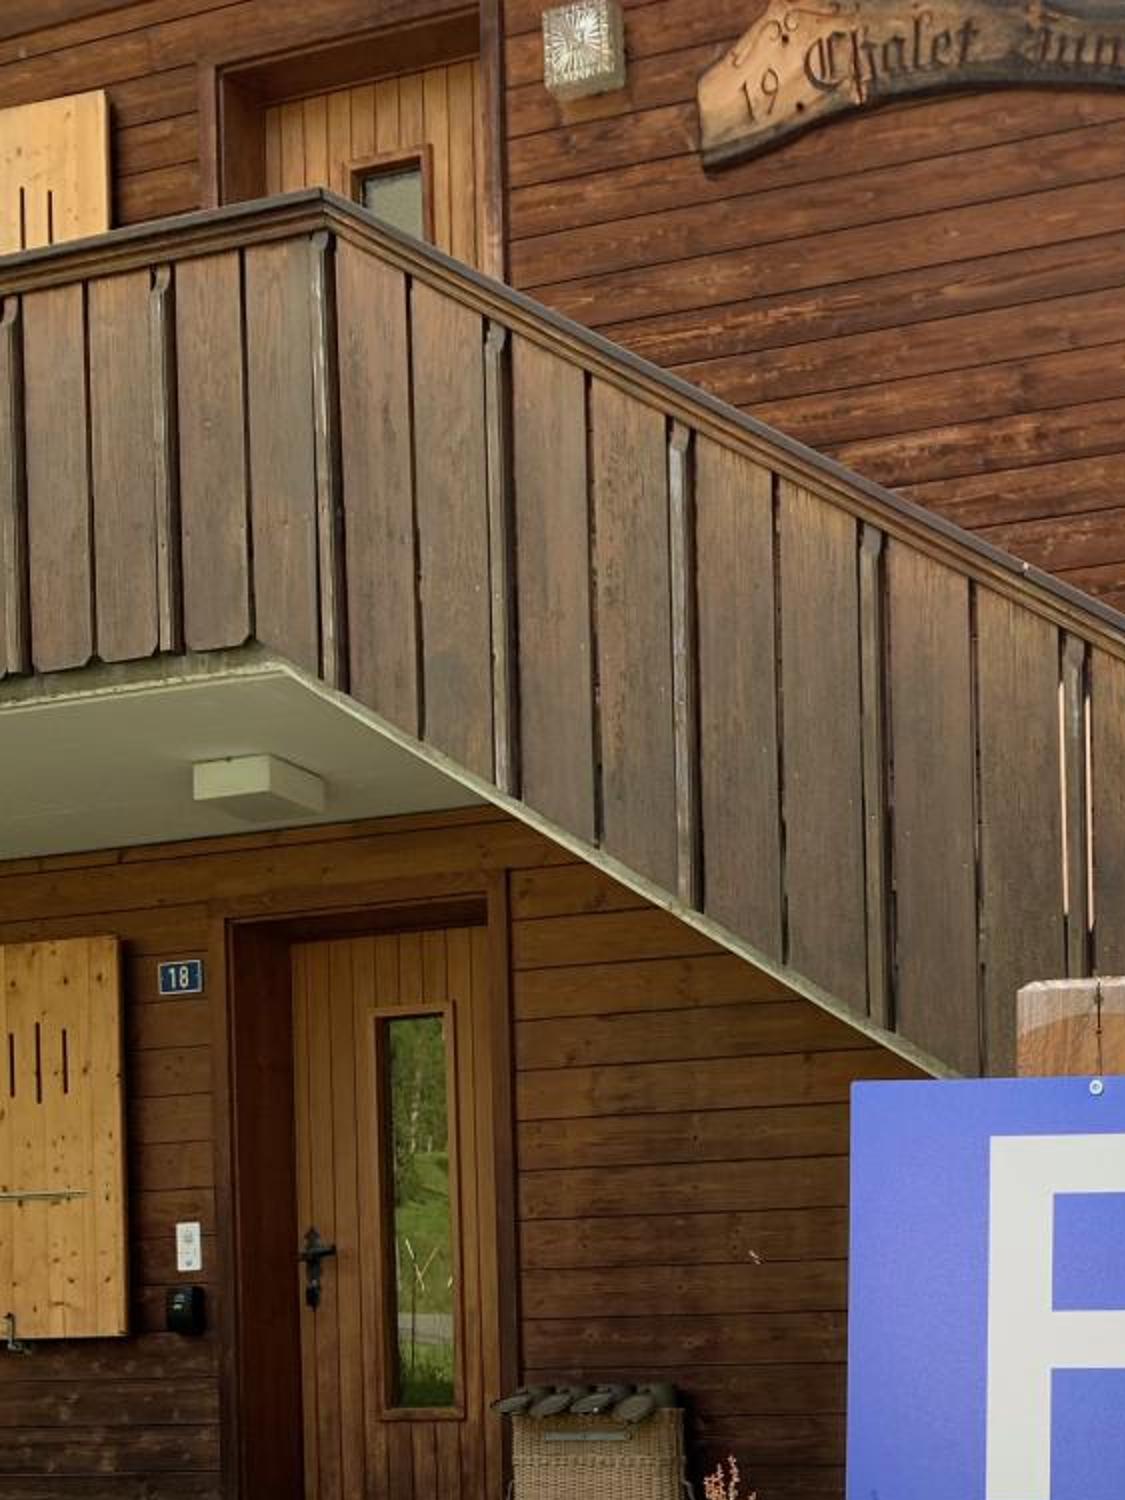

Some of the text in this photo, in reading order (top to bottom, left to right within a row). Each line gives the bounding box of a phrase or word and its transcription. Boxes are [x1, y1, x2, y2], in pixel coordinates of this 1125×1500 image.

[742, 67, 780, 122] 19
[804, 8, 980, 106] Chalet
[168, 965, 189, 990] 18
